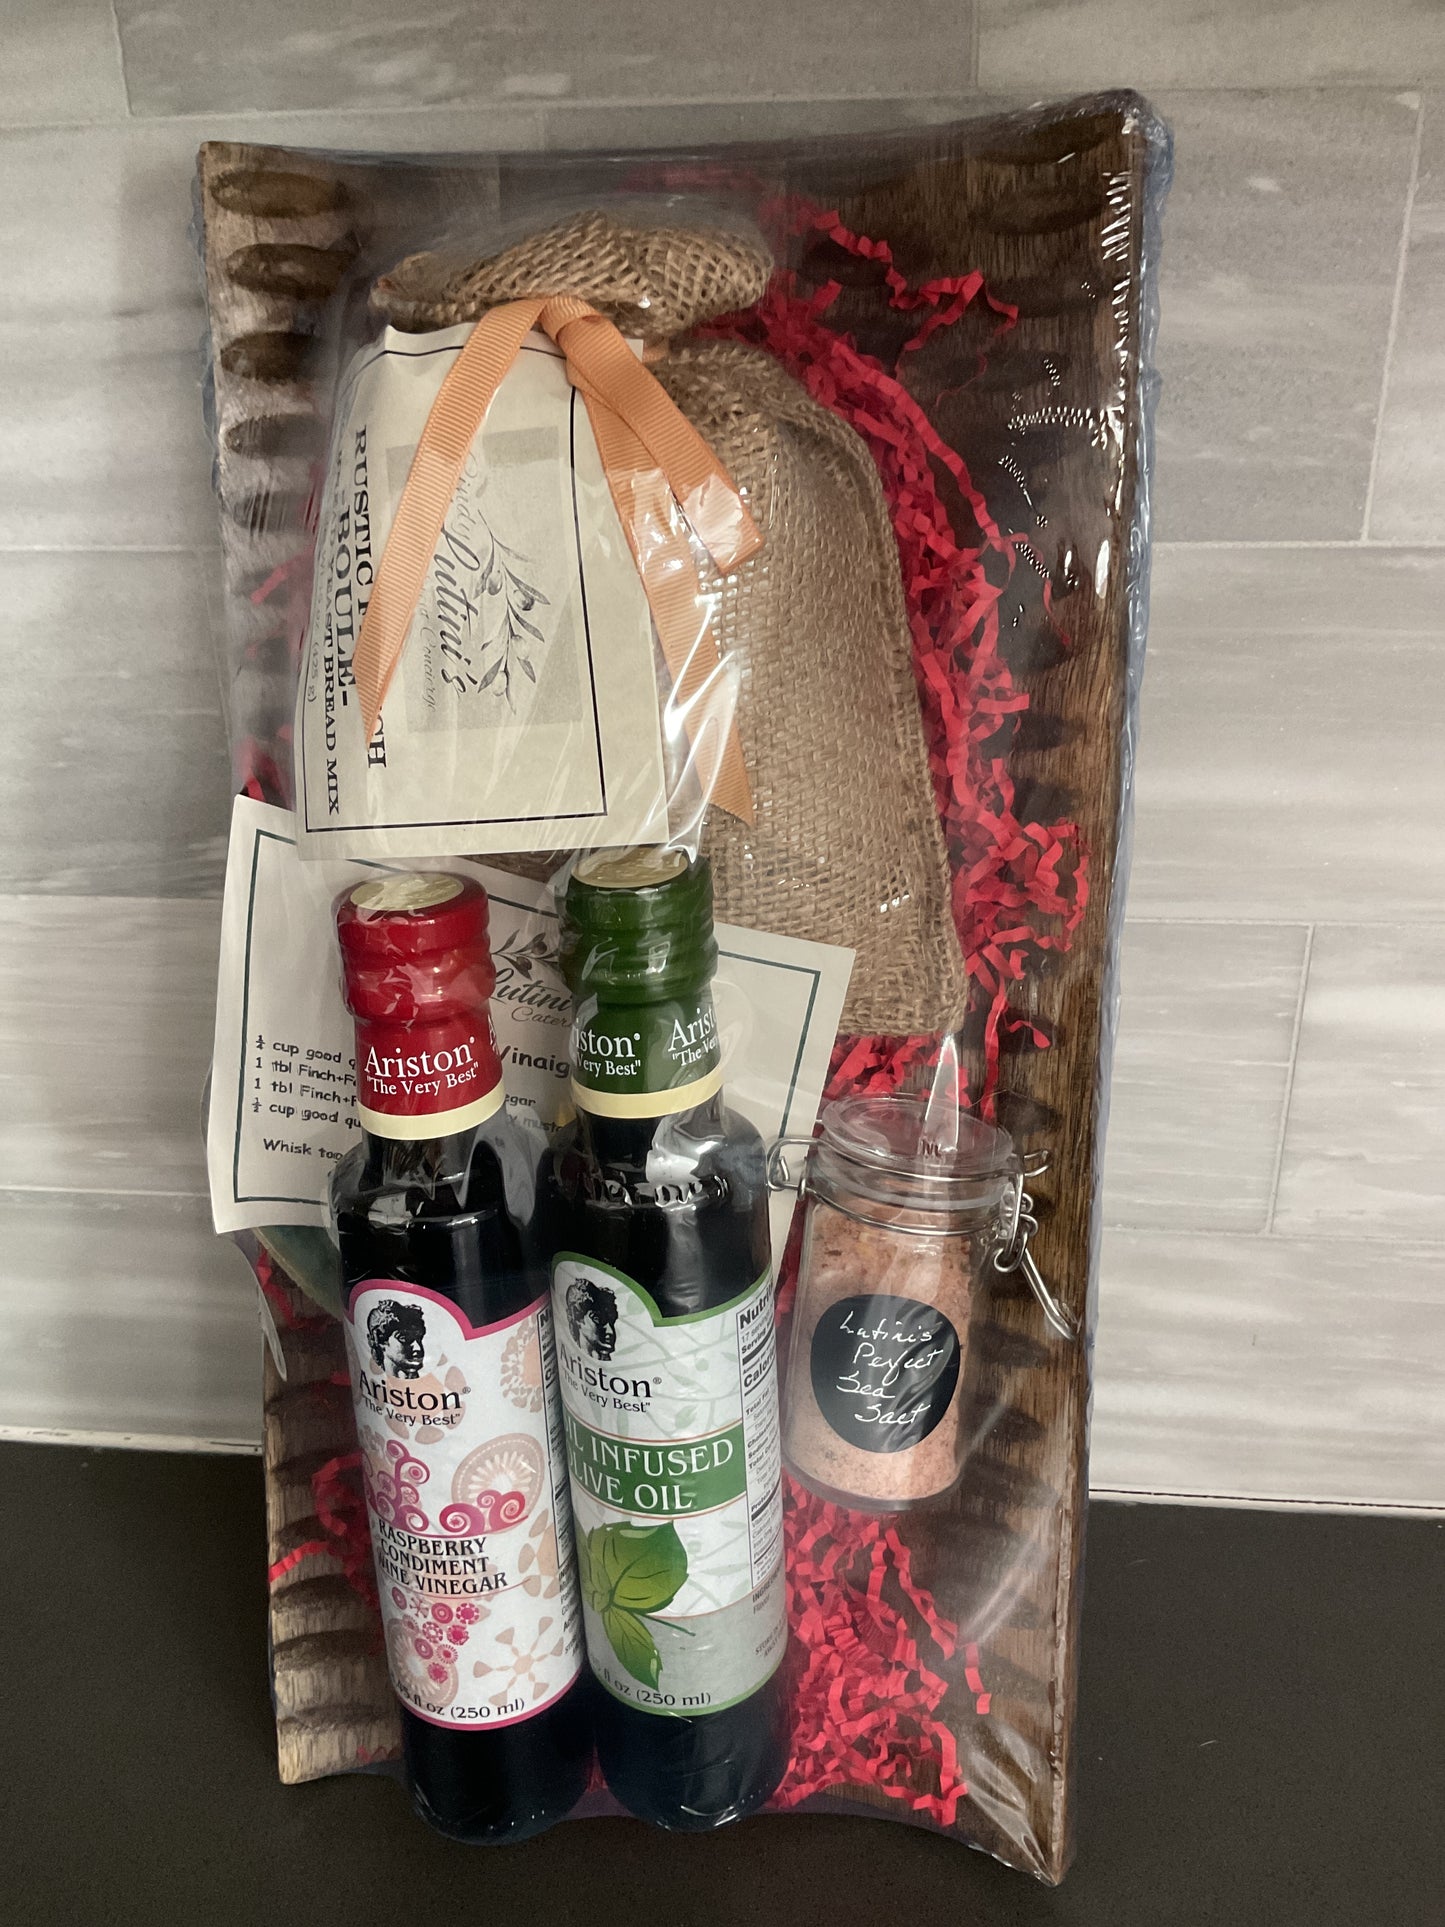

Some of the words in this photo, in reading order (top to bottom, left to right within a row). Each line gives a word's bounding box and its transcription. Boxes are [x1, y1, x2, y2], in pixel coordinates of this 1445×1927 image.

[353, 424, 374, 587] RUSTIC
[323, 655, 337, 751] BREAD
[326, 757, 339, 816] MIX
[511, 1006, 574, 1028] Cater
[668, 1007, 717, 1052] Arist
[574, 1017, 640, 1058] iston
[272, 1041, 299, 1057] cup
[306, 1048, 342, 1063] good
[364, 1040, 474, 1078] Ariston
[256, 1057, 262, 1069] 1
[271, 1060, 292, 1074] tbl
[605, 1059, 641, 1076] Best"
[254, 1078, 261, 1090] 1
[271, 1081, 293, 1094] tbl
[299, 1083, 357, 1107] Finch+F
[400, 1080, 440, 1096] Very
[269, 1104, 295, 1118] cup
[302, 1109, 339, 1123] good
[263, 1138, 312, 1156] Whisk
[581, 1383, 608, 1408] Very
[836, 1370, 896, 1399] Sea
[386, 1407, 417, 1427] Very
[590, 1436, 734, 1477] INFUSED
[634, 1483, 693, 1511] OIL
[378, 1517, 487, 1556] RASPBERRY
[380, 1538, 490, 1575] CONDIMENT
[414, 1571, 509, 1595] VINEGAR
[426, 1703, 445, 1716] oz
[450, 1706, 491, 1721] (250
[497, 1697, 525, 1716] ml)
[635, 1689, 676, 1706] (250
[682, 1691, 712, 1706] ml)
